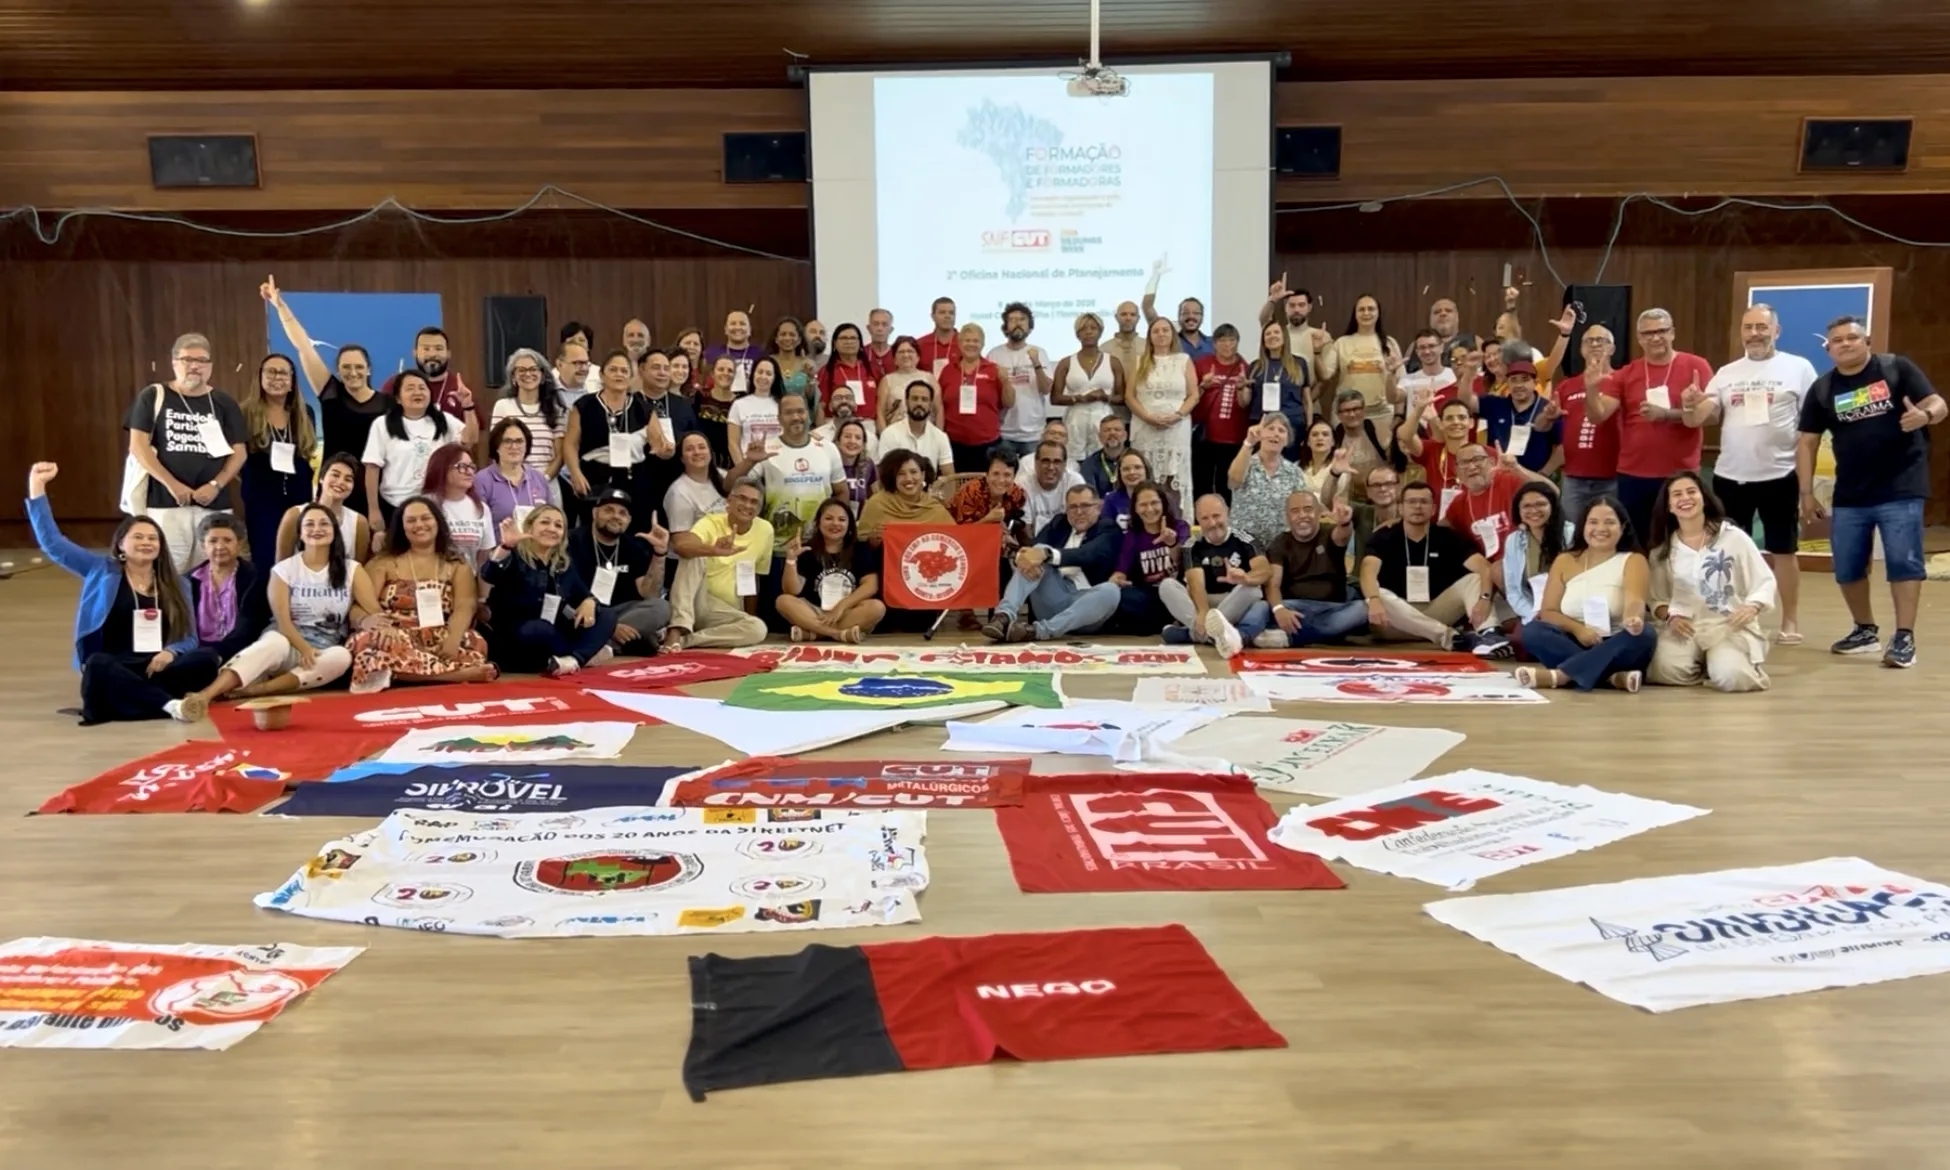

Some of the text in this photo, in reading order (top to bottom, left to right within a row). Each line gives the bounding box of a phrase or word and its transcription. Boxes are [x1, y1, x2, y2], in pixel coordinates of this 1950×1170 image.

[1026, 144, 1121, 163] FORMAÇÃO
[1025, 164, 1121, 175] DE FORMADORES
[1037, 176, 1121, 188] FORMADORAS
[960, 269, 998, 280] Oficina
[1002, 268, 1049, 279] Nacional
[1052, 268, 1065, 278] de
[1069, 266, 1144, 279] Planejamento
[1837, 400, 1894, 422] RORAIMA
[353, 697, 555, 722] CUT
[703, 793, 979, 806] CNM/CUT
[1110, 860, 1277, 871] BRASIL
[976, 979, 1117, 999] NEGO
